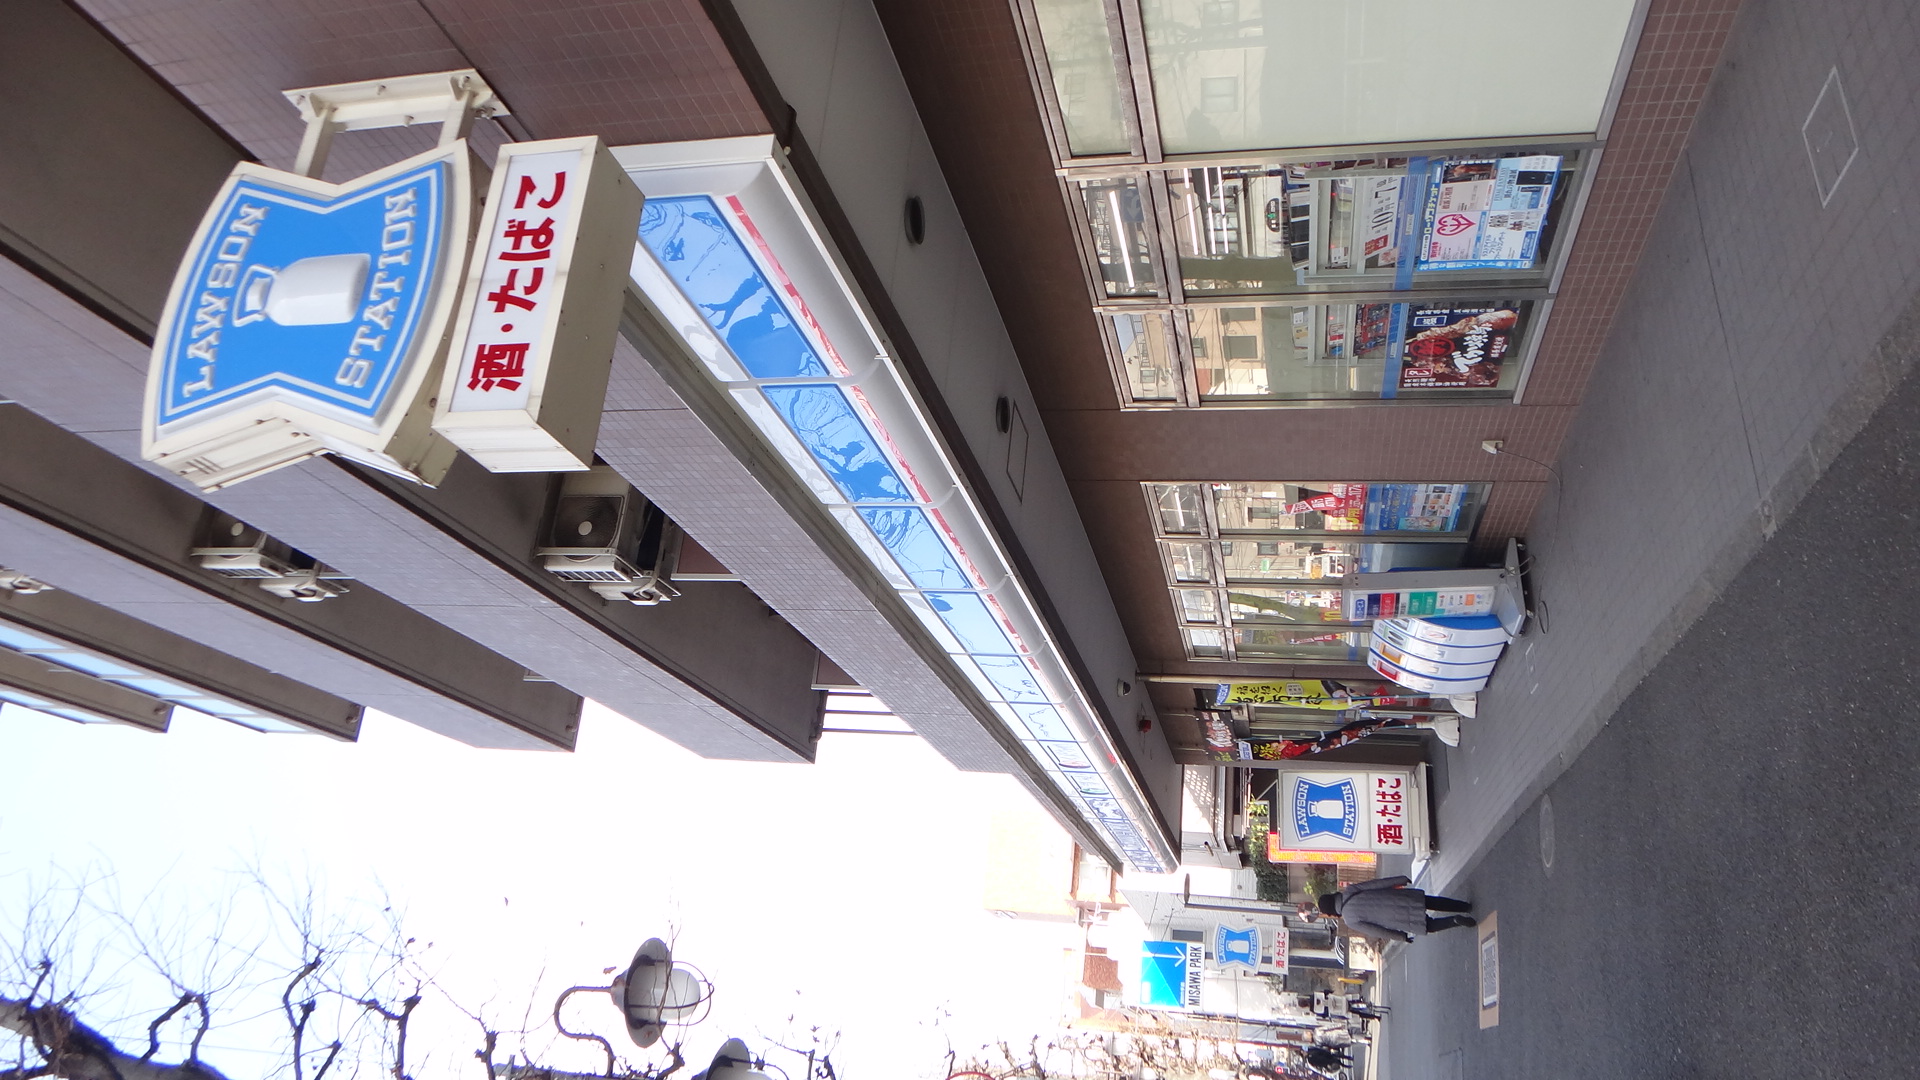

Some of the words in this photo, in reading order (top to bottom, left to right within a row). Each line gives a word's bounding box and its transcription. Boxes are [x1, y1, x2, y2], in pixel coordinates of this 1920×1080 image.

[335, 188, 418, 388] STATION
[467, 170, 568, 392] 酒・たばこ
[183, 204, 268, 398] LAWSON
[1324, 497, 1336, 507] ATM
[1236, 685, 1282, 695] 福を招く
[1298, 783, 1311, 834] LAWSON
[1341, 784, 1355, 835] STATION
[1376, 778, 1403, 845] 酒・たばこ
[1190, 946, 1202, 968] PARK
[1219, 928, 1227, 963] LAWSON
[1248, 931, 1257, 964] STATION
[1276, 931, 1286, 968] 酒・たばこ
[1189, 971, 1201, 1006] MISAWA
